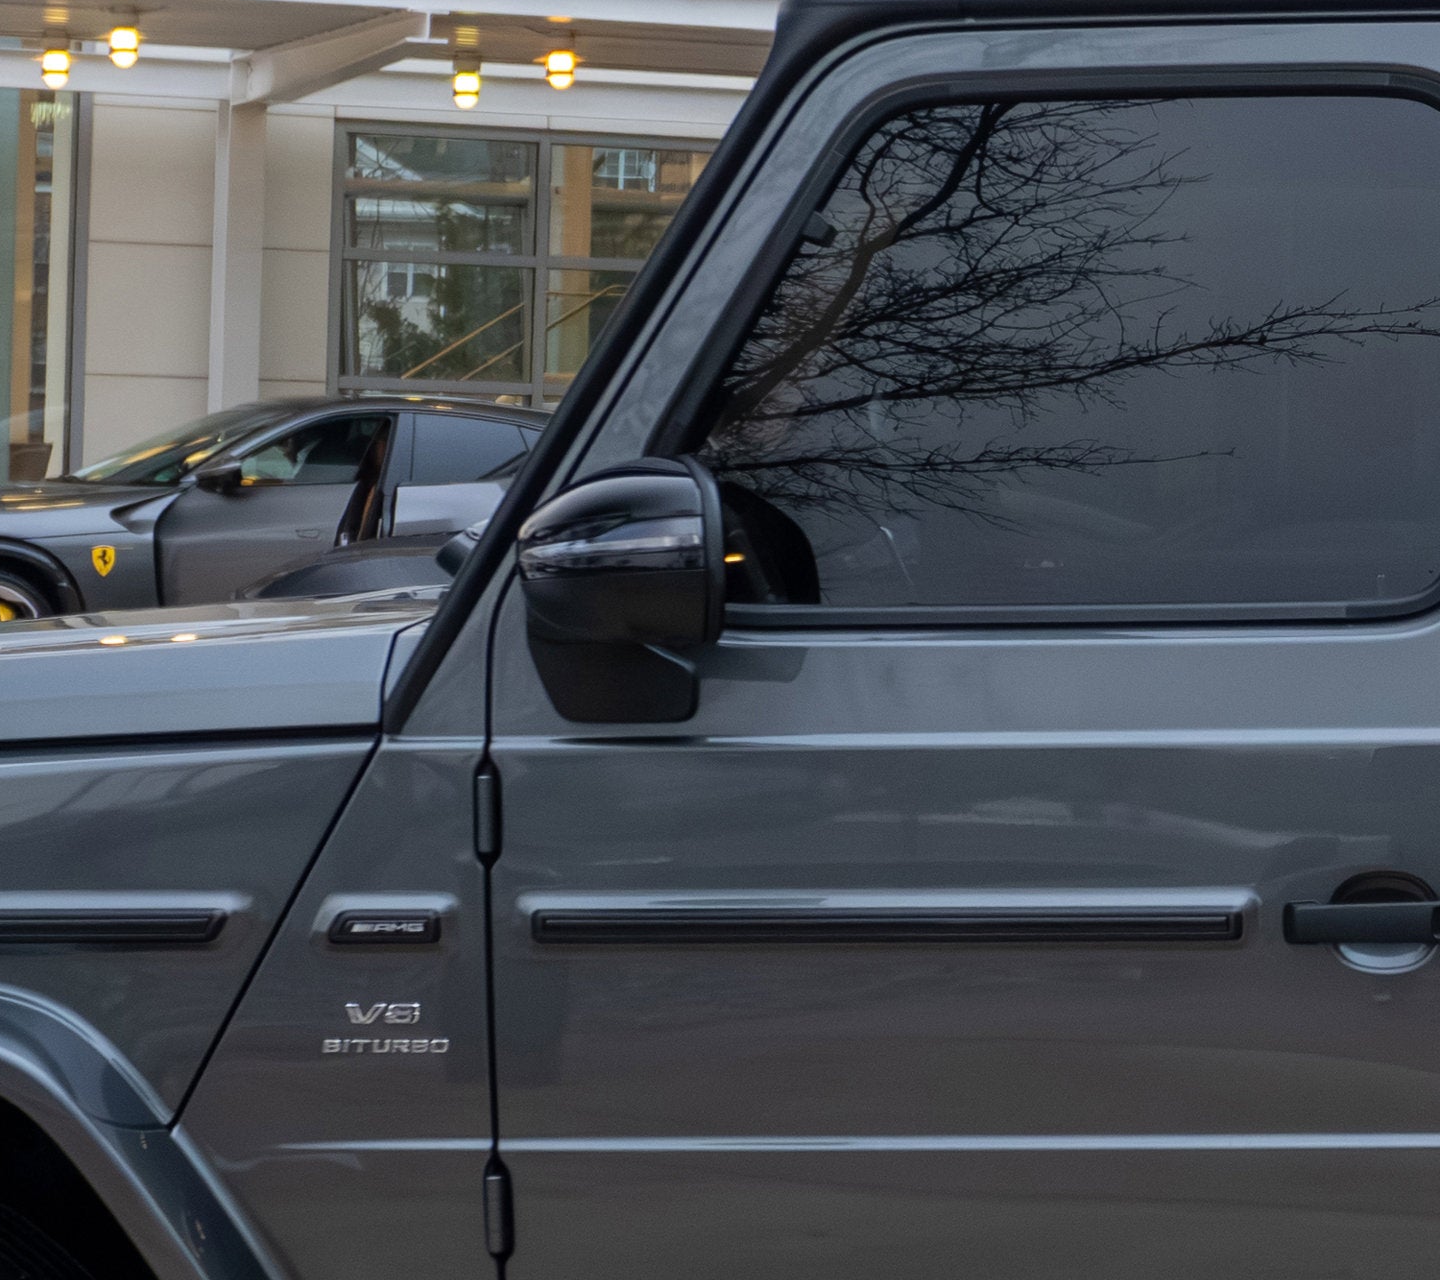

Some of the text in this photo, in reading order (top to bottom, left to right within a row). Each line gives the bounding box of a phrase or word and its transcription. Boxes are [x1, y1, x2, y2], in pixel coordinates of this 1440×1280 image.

[365, 922, 425, 933] AMG
[345, 1002, 421, 1024] V8
[321, 1038, 450, 1054] BITURBO
